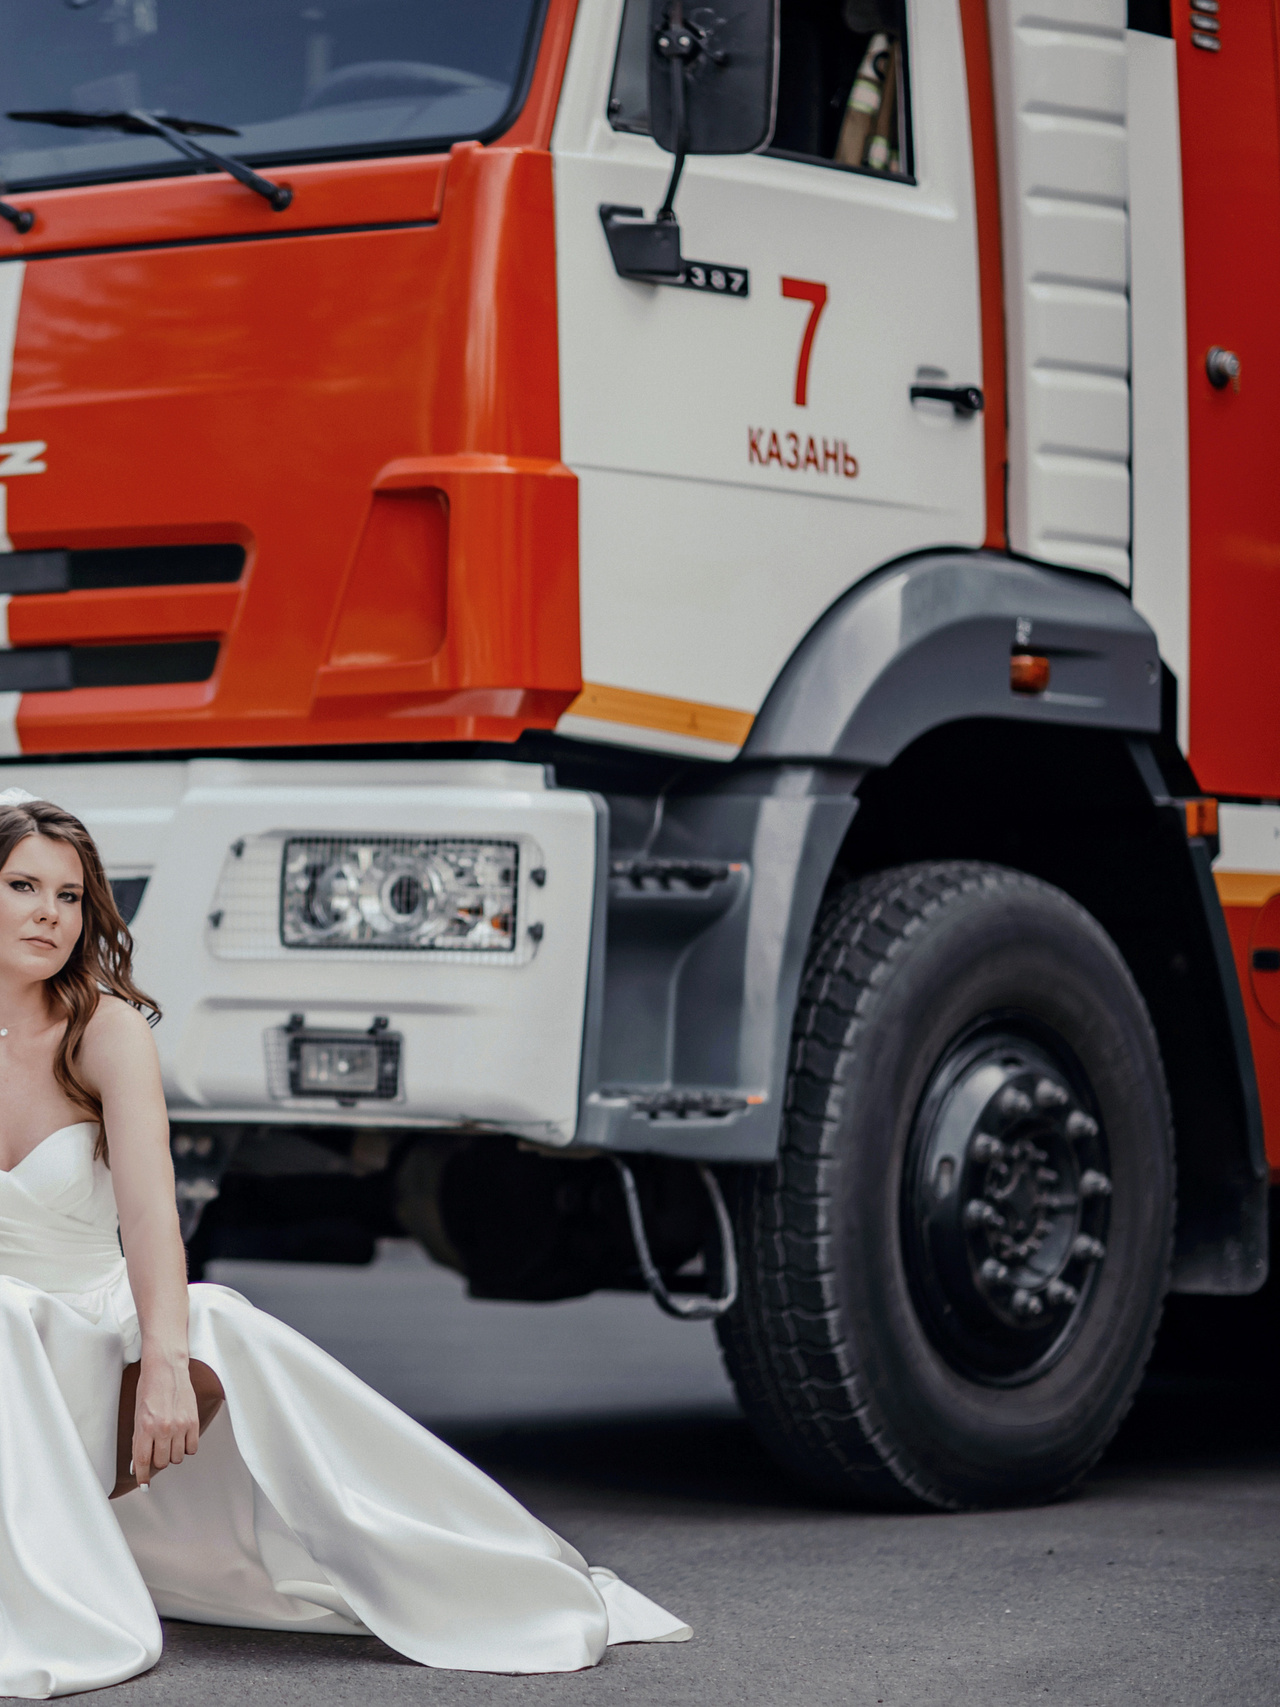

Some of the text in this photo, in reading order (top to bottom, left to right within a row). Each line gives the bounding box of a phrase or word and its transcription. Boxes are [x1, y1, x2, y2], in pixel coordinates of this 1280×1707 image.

[677, 266, 745, 292] 387
[780, 275, 828, 407] 7
[748, 425, 859, 478] КАЗАНЬ
